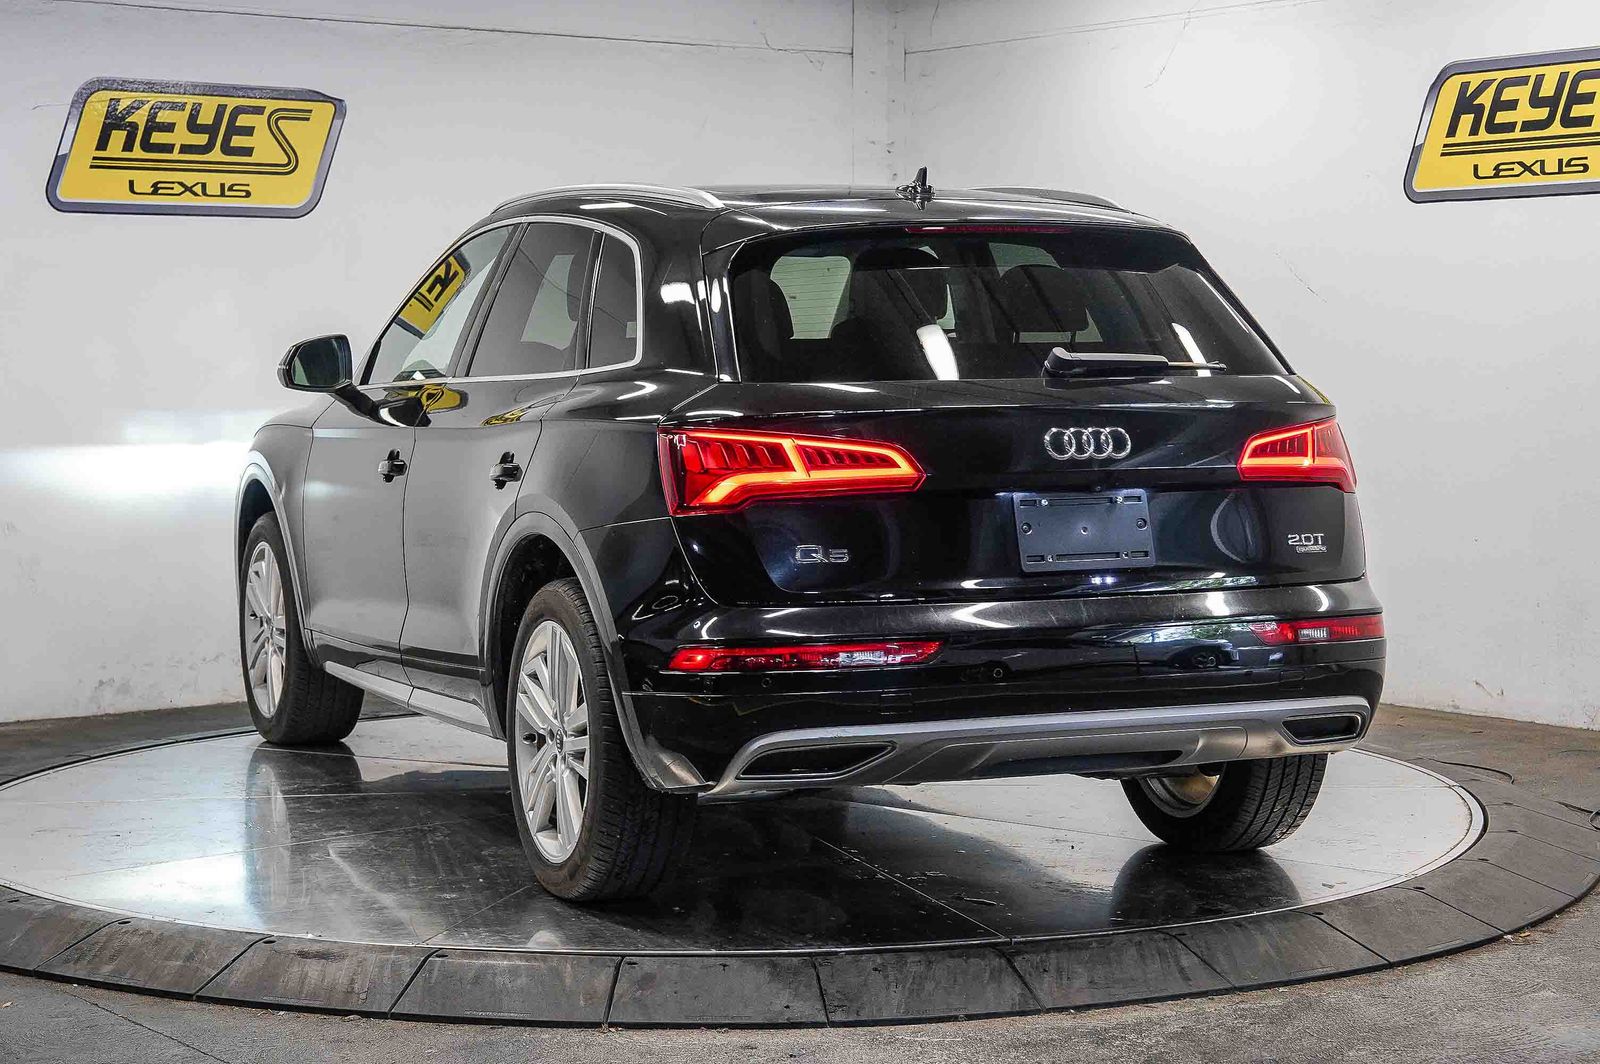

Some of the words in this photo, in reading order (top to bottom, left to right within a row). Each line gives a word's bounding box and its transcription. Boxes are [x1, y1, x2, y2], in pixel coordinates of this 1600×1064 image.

[92, 97, 313, 175] KEYES
[1473, 156, 1590, 180] LEXUS
[128, 179, 252, 199] LEXUS
[795, 544, 849, 564] Q5
